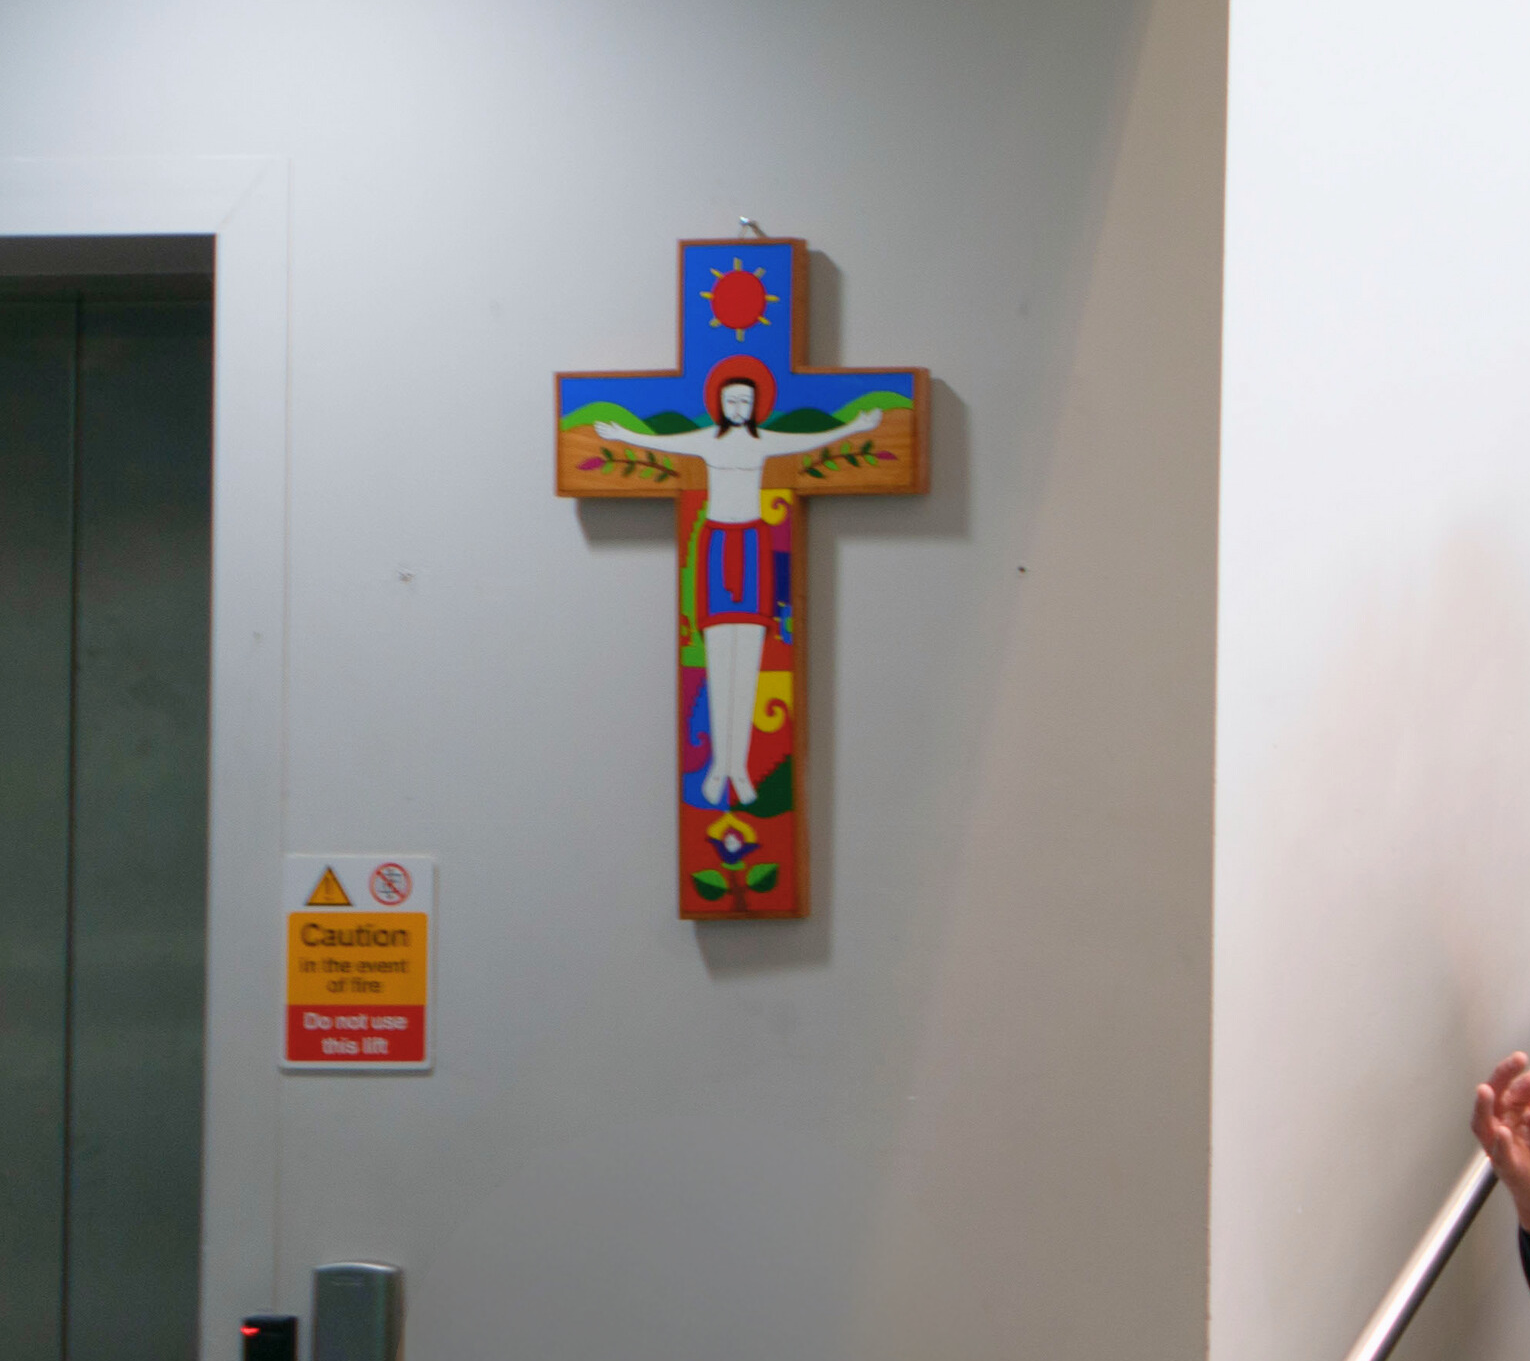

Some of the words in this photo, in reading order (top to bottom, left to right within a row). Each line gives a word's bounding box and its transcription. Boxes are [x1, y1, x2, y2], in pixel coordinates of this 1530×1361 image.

[301, 923, 411, 948] Caution
[321, 958, 352, 974] the
[356, 960, 408, 974] event
[326, 978, 347, 994] of
[351, 978, 382, 994] fire
[303, 1012, 333, 1031] Do
[335, 1014, 368, 1031] not
[371, 1016, 408, 1031] use
[321, 1037, 359, 1055] this
[362, 1037, 389, 1055] lift
